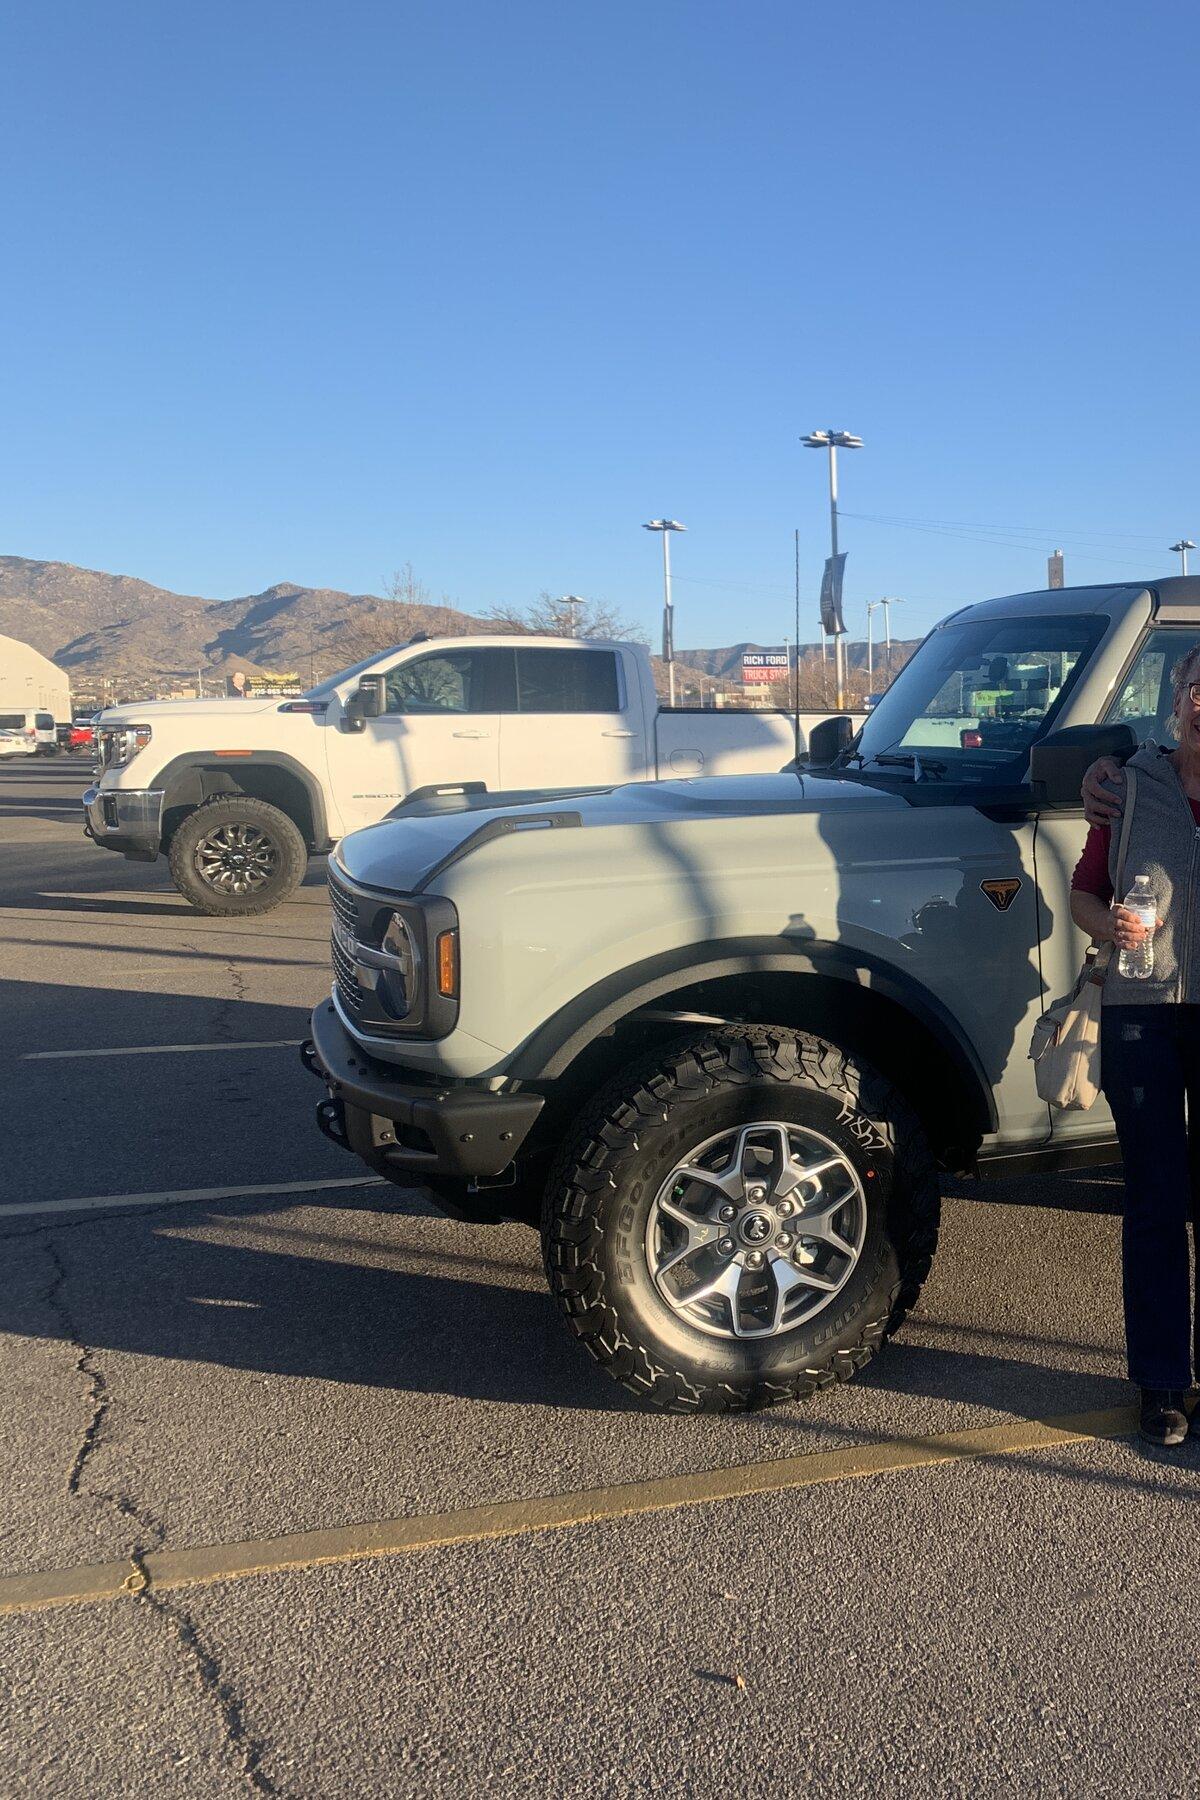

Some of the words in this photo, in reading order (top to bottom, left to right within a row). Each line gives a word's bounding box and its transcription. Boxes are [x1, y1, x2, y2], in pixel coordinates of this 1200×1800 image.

[743, 655, 764, 665] RICH
[765, 655, 787, 665] FORD
[744, 669, 768, 680] TRUCK
